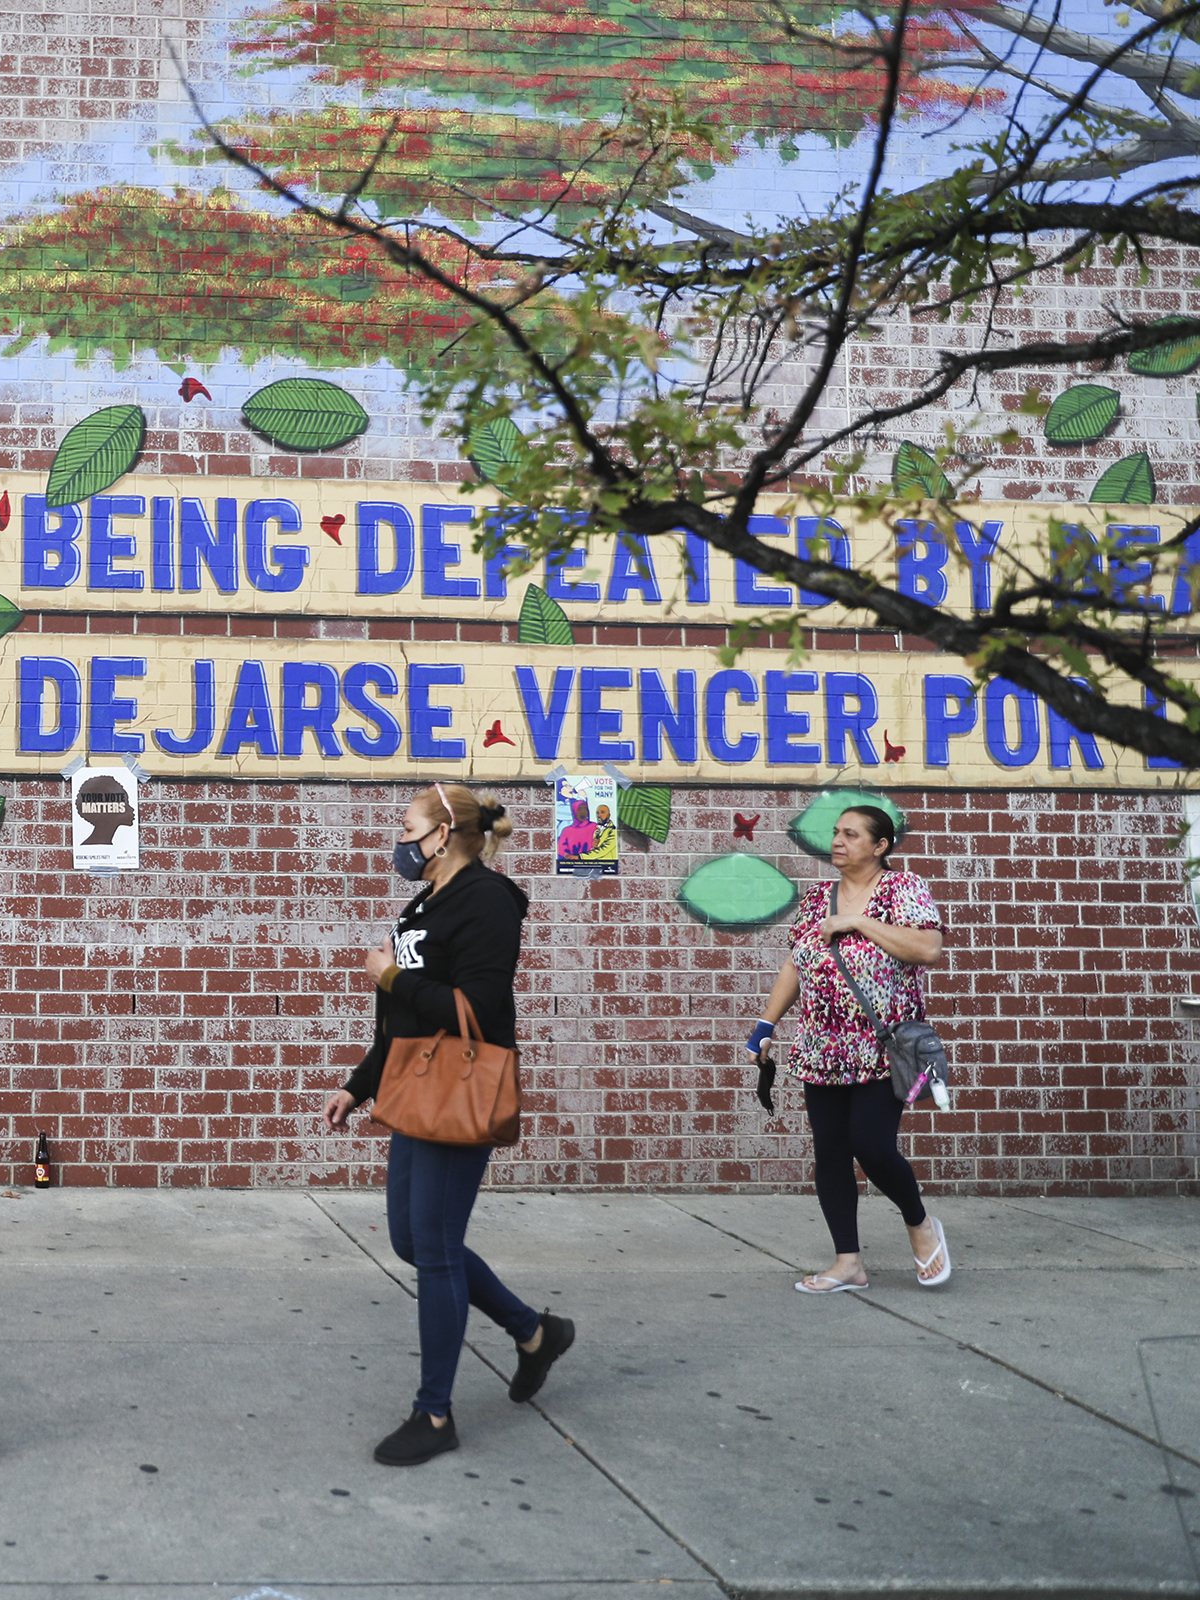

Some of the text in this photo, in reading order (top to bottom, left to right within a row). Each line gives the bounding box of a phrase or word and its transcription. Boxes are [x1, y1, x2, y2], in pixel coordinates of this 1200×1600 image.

[22, 494, 310, 592] BEING
[896, 518, 1005, 612] BY
[515, 665, 881, 765] VENCER
[81, 793, 125, 802] YOUR VOTE
[81, 802, 126, 813] MATTERS
